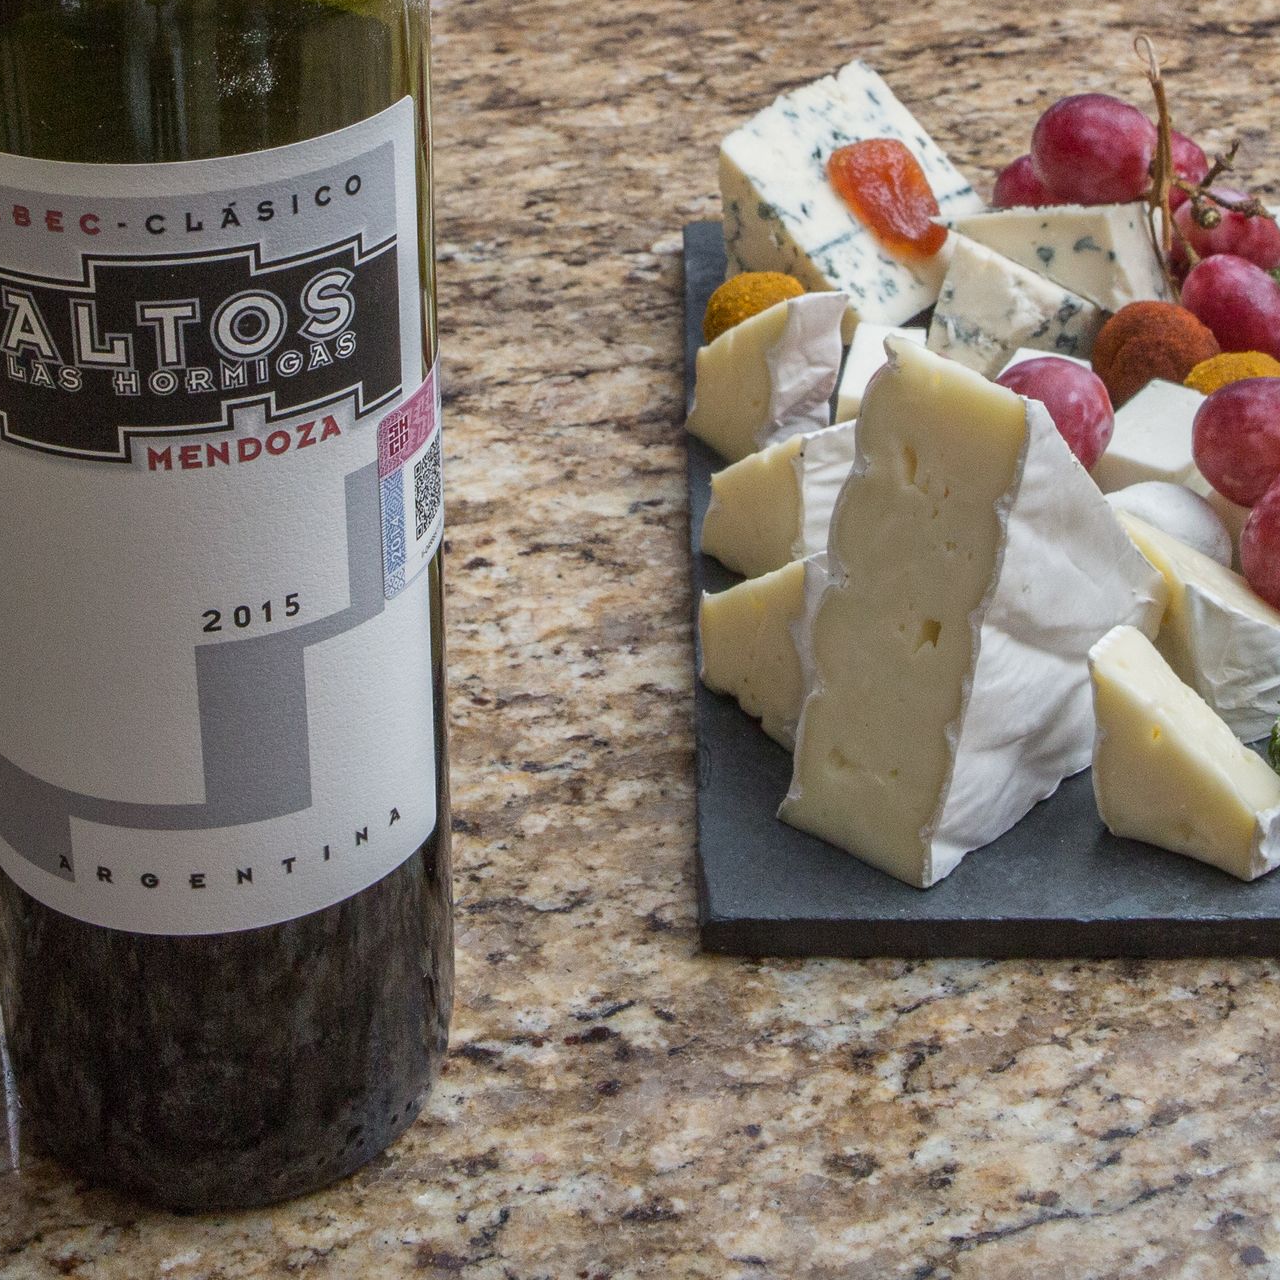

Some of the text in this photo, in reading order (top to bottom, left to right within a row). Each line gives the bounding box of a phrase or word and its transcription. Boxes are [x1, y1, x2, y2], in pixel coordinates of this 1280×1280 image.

[0, 267, 356, 370] ALTOS
[6, 330, 357, 396] LAS HORMIGAS
[146, 415, 343, 471] MENDOZA
[201, 592, 302, 633] 2015
[58, 807, 402, 889] ARGENTINA
